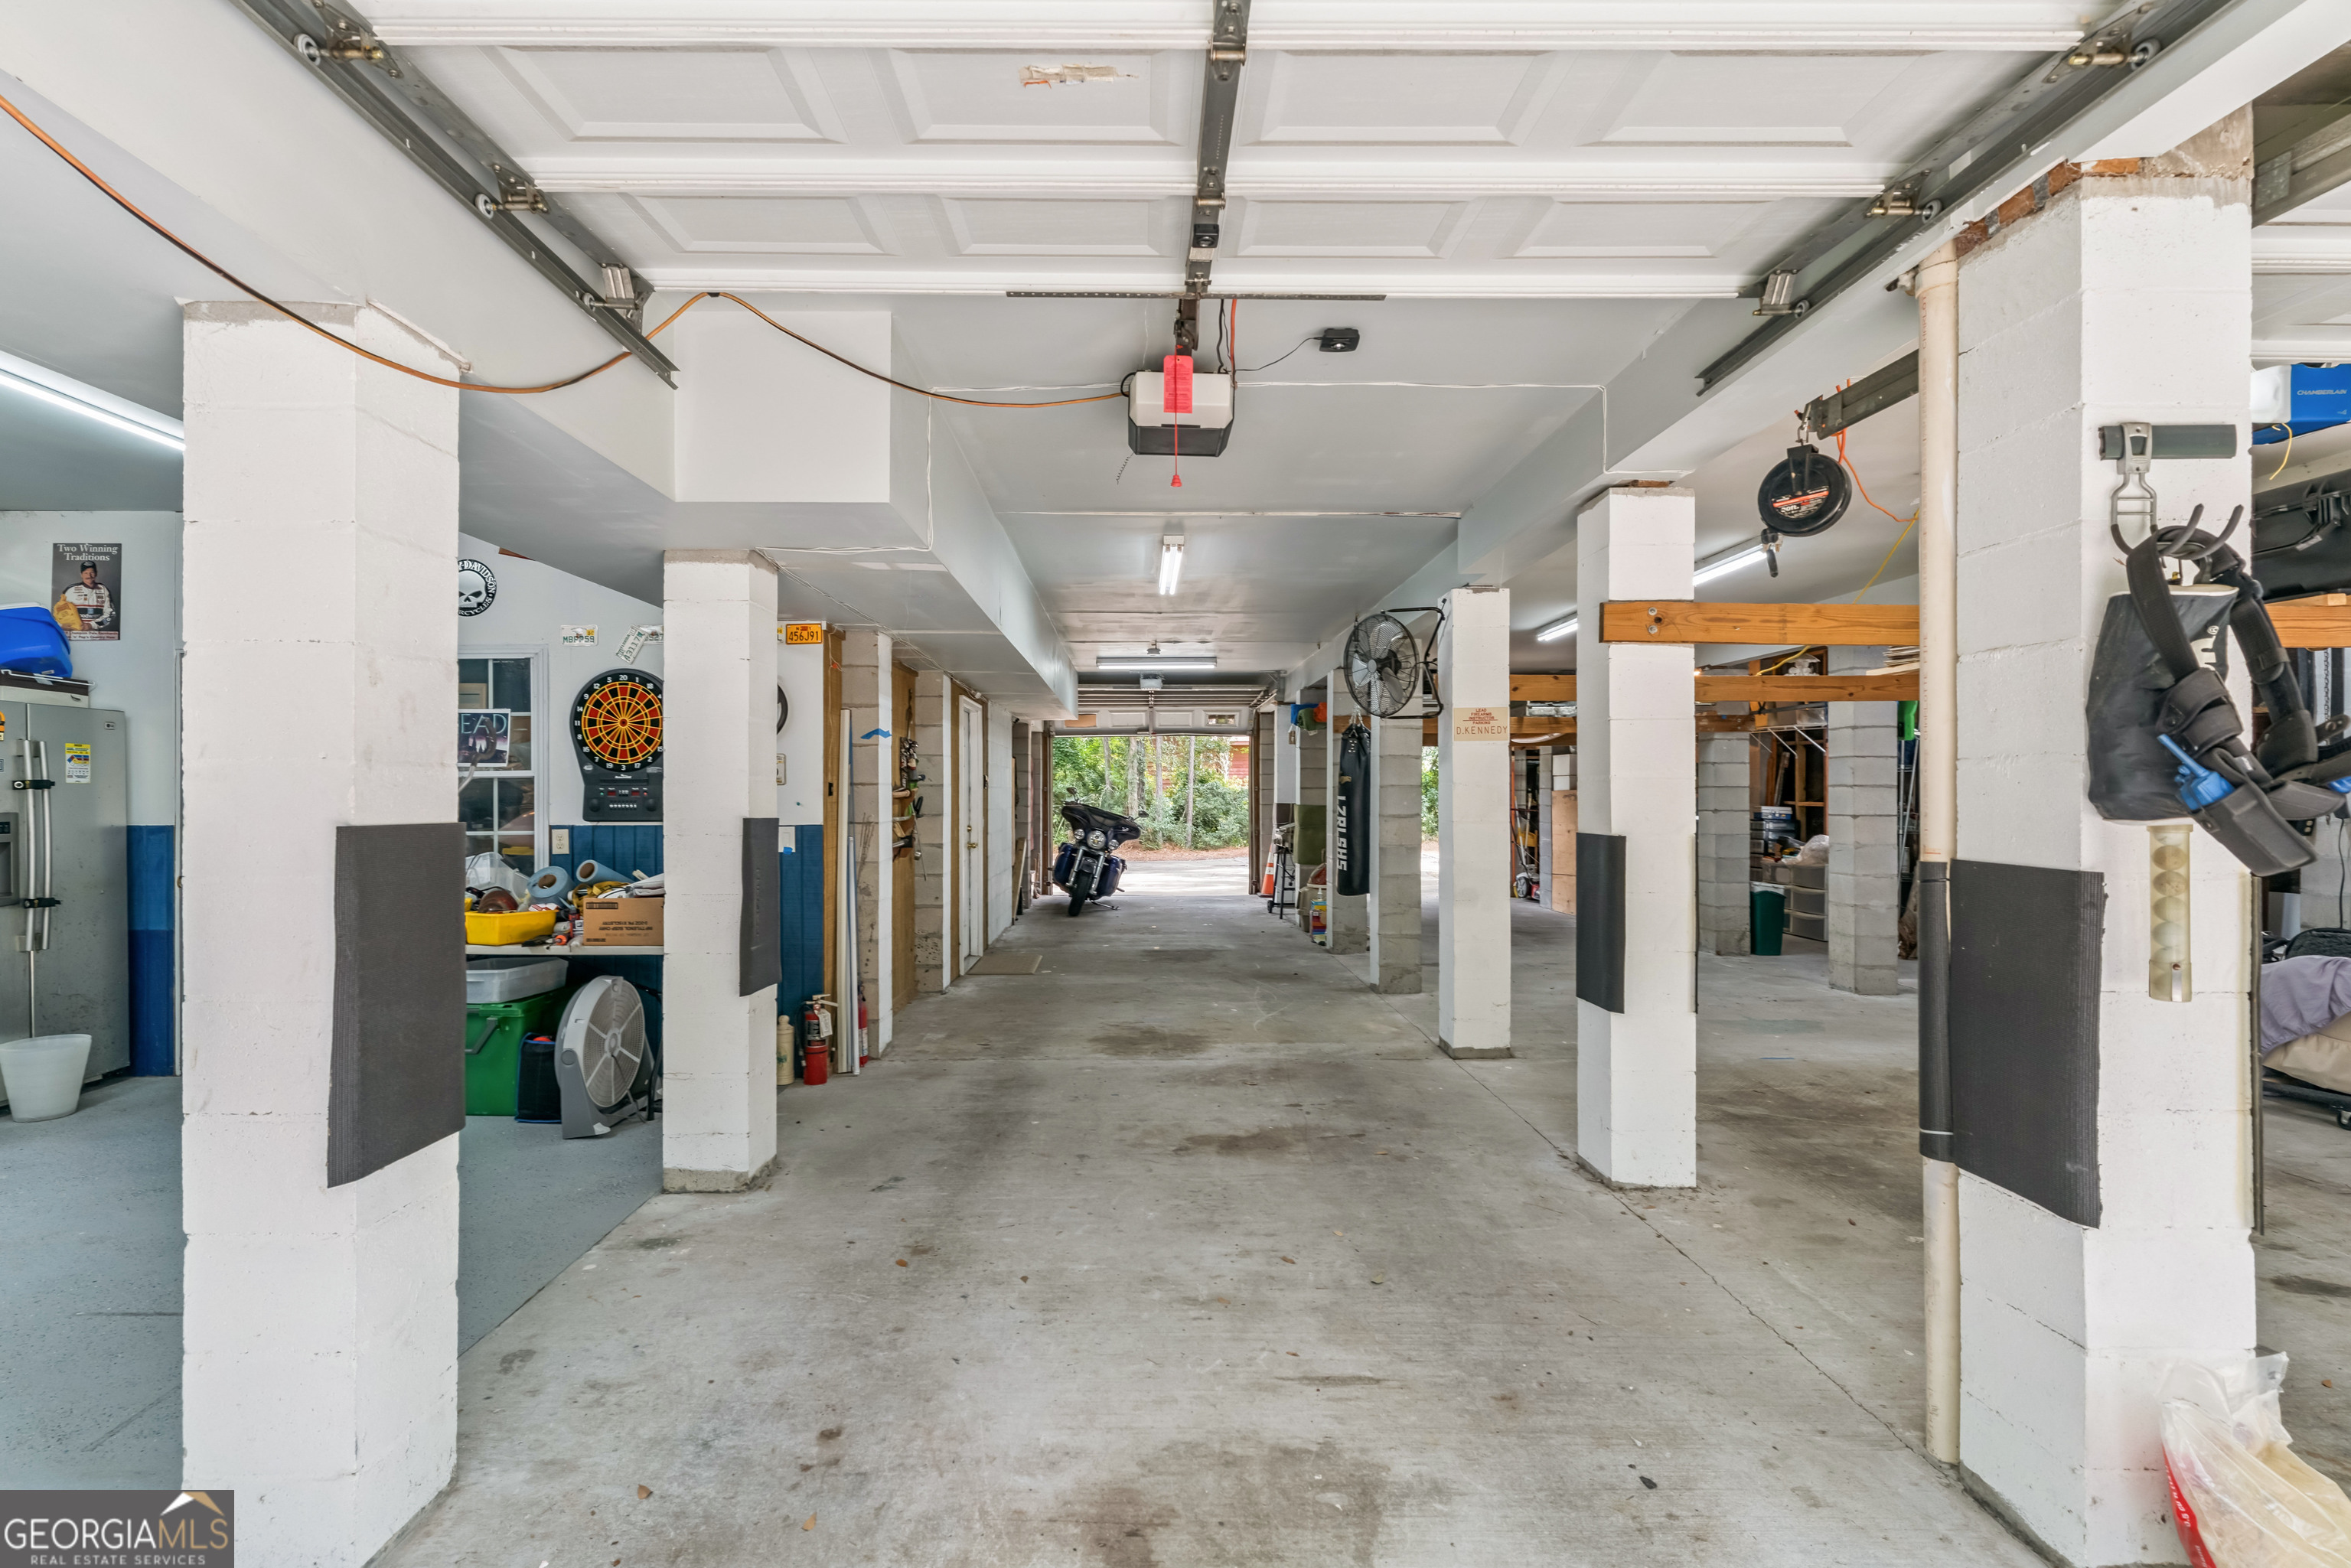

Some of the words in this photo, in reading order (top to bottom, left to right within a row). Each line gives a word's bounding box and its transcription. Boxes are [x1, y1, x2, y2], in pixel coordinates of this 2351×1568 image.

[57, 543, 77, 552] Two
[80, 543, 119, 555] Winning
[64, 553, 110, 561] Traditions
[788, 631, 819, 641] 456J91
[1456, 726, 1508, 735] D.KENNEDY
